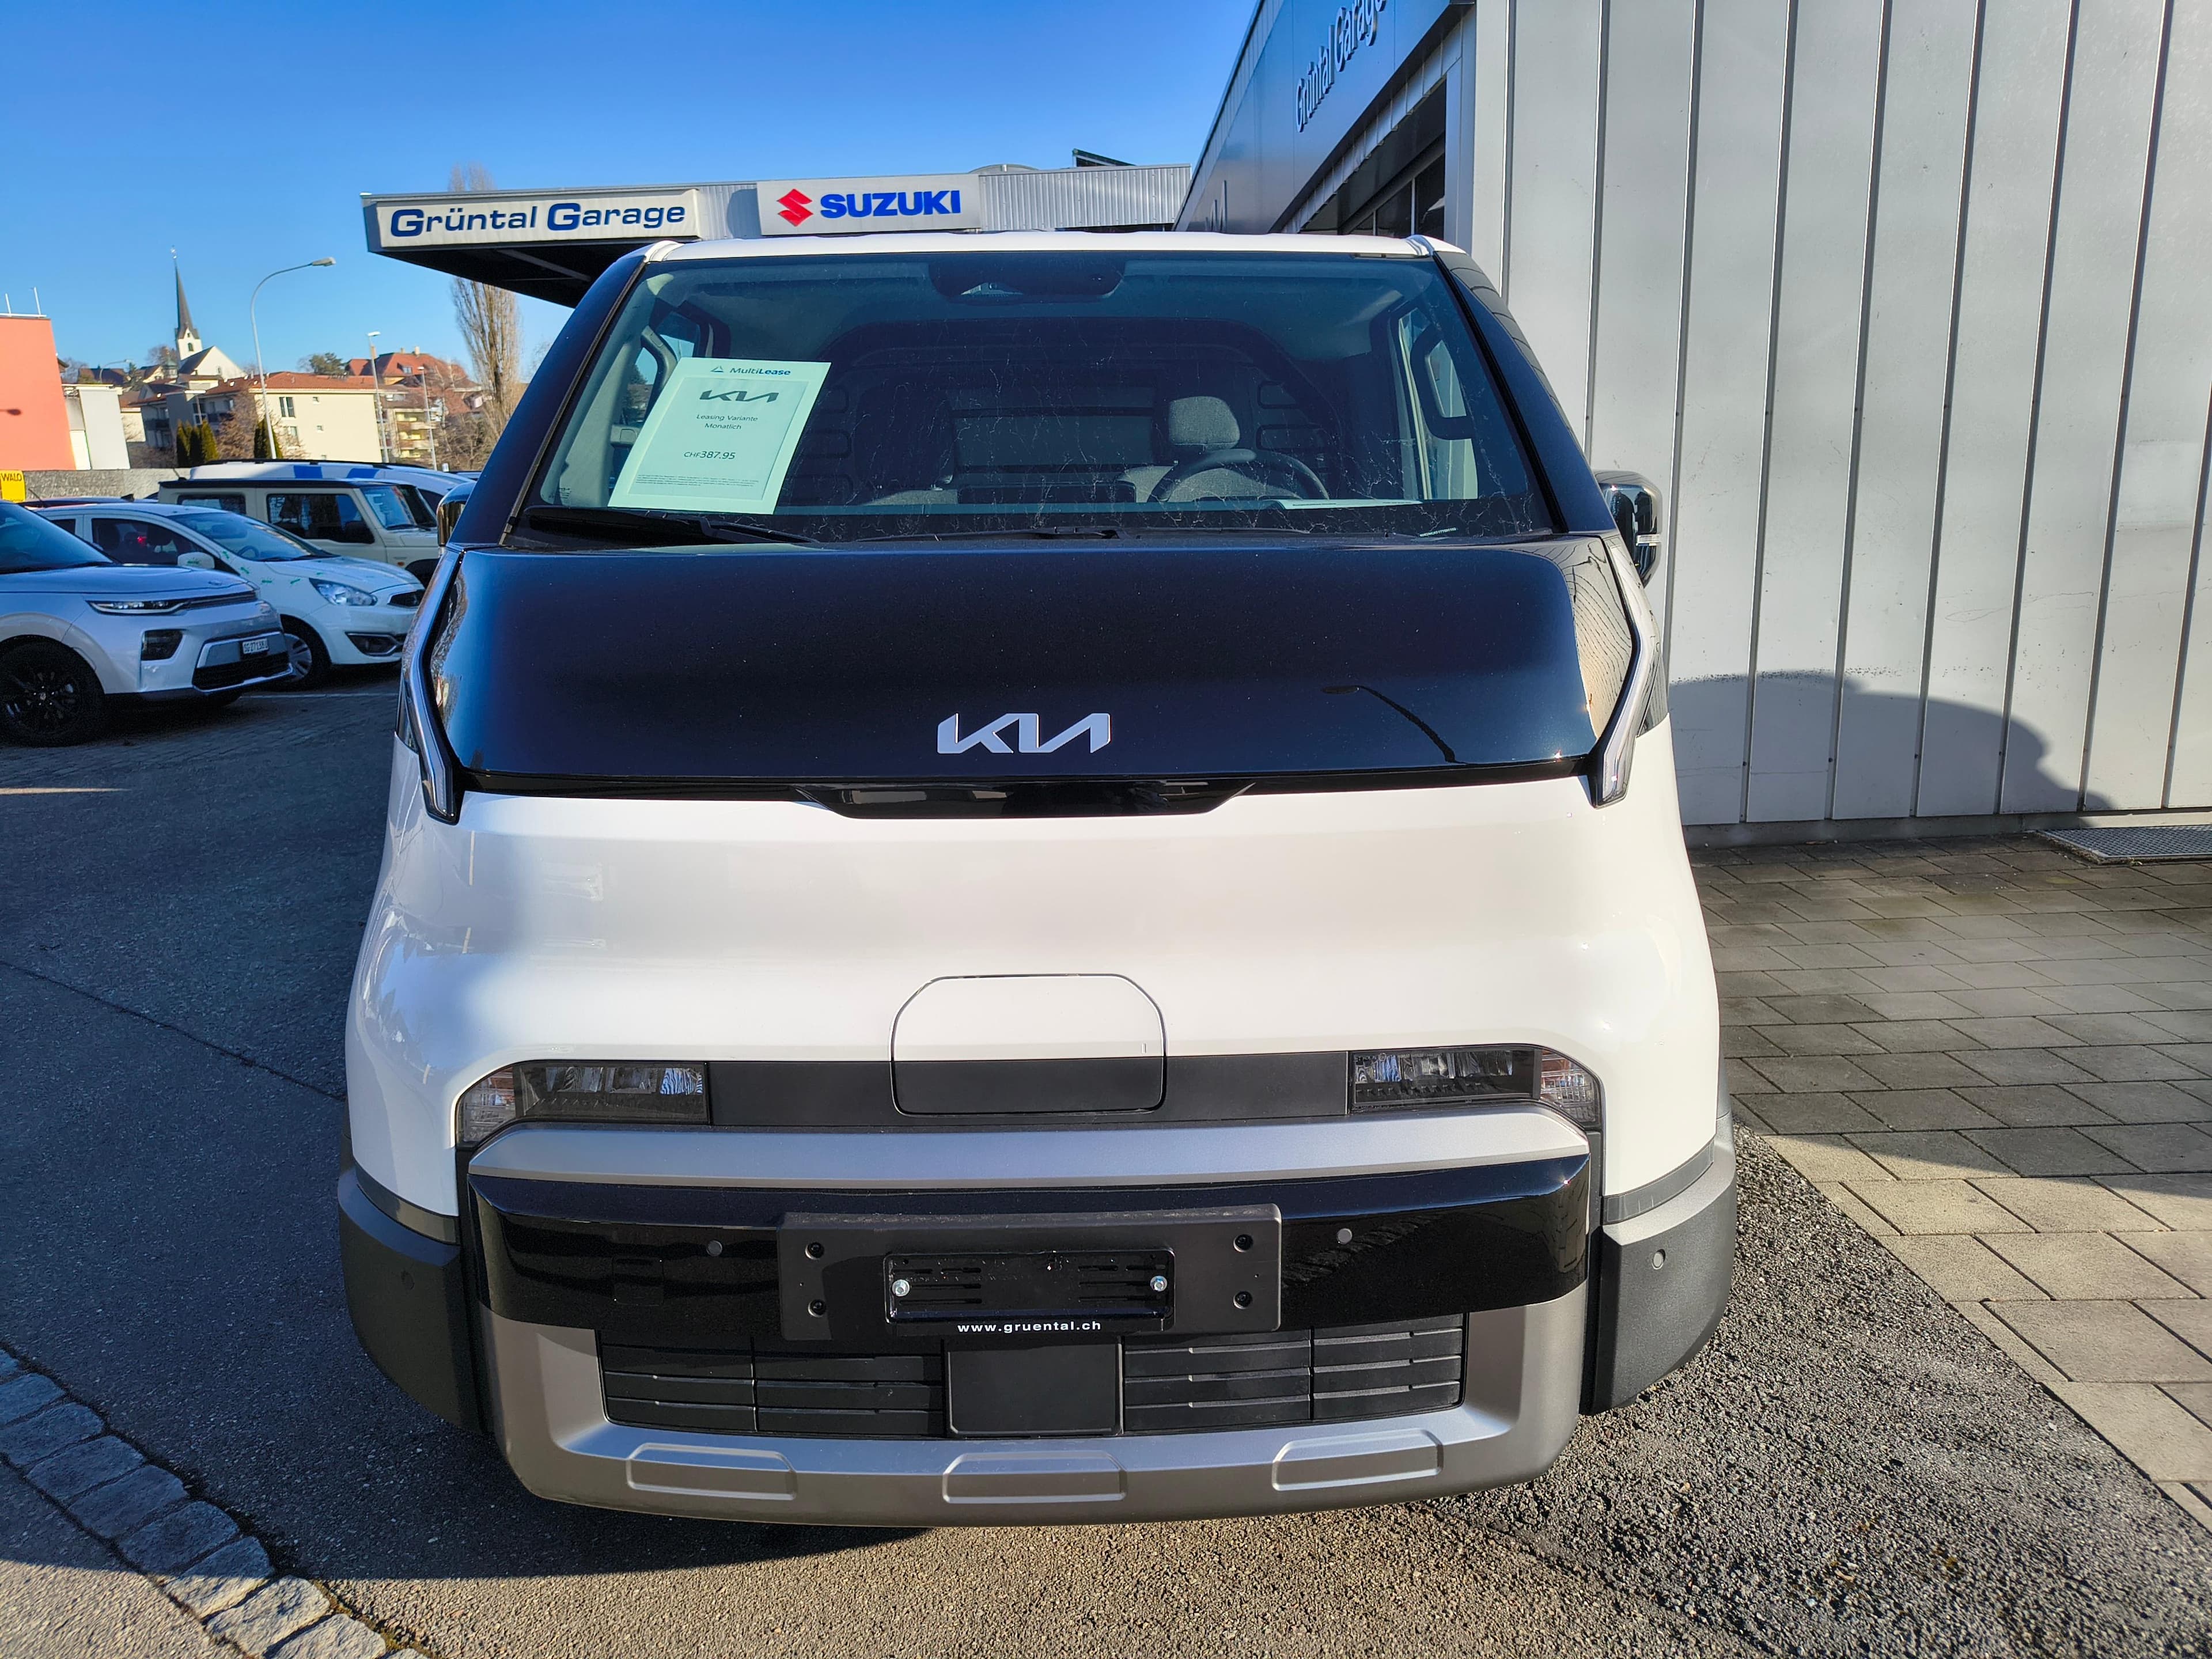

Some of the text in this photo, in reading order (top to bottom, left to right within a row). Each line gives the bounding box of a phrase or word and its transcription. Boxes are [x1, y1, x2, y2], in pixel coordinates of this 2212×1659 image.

[1334, 0, 1387, 72] Garag
[820, 190, 961, 218] SUZUKI
[390, 203, 685, 237] Grüntal Garage
[699, 389, 779, 403] KIA
[684, 451, 736, 460] CHF387.95
[937, 713, 1111, 754] KIA
[957, 1321, 1101, 1334] www.gruental.ch
